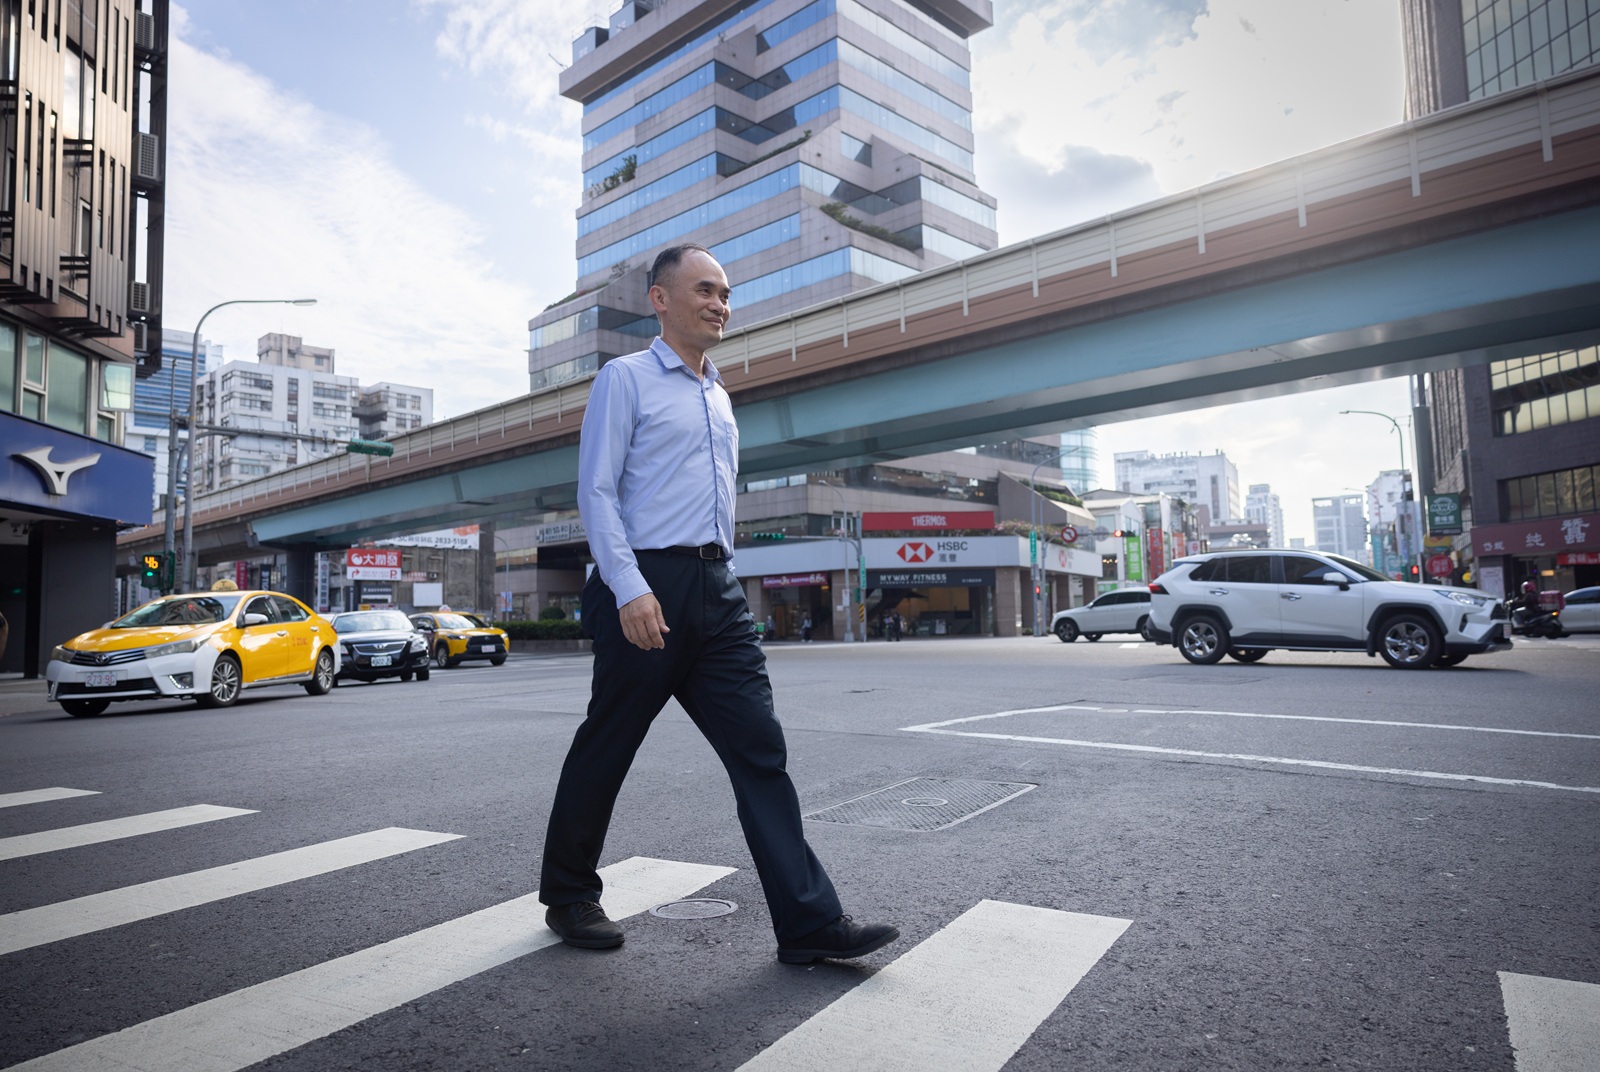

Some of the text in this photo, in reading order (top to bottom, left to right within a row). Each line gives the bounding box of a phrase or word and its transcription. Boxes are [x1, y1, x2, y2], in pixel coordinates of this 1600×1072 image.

[911, 515, 947, 527] THERMOS
[937, 541, 968, 551] HSBC
[362, 553, 398, 567] 大潤發
[389, 569, 398, 579] P
[913, 573, 947, 581] FITNESS
